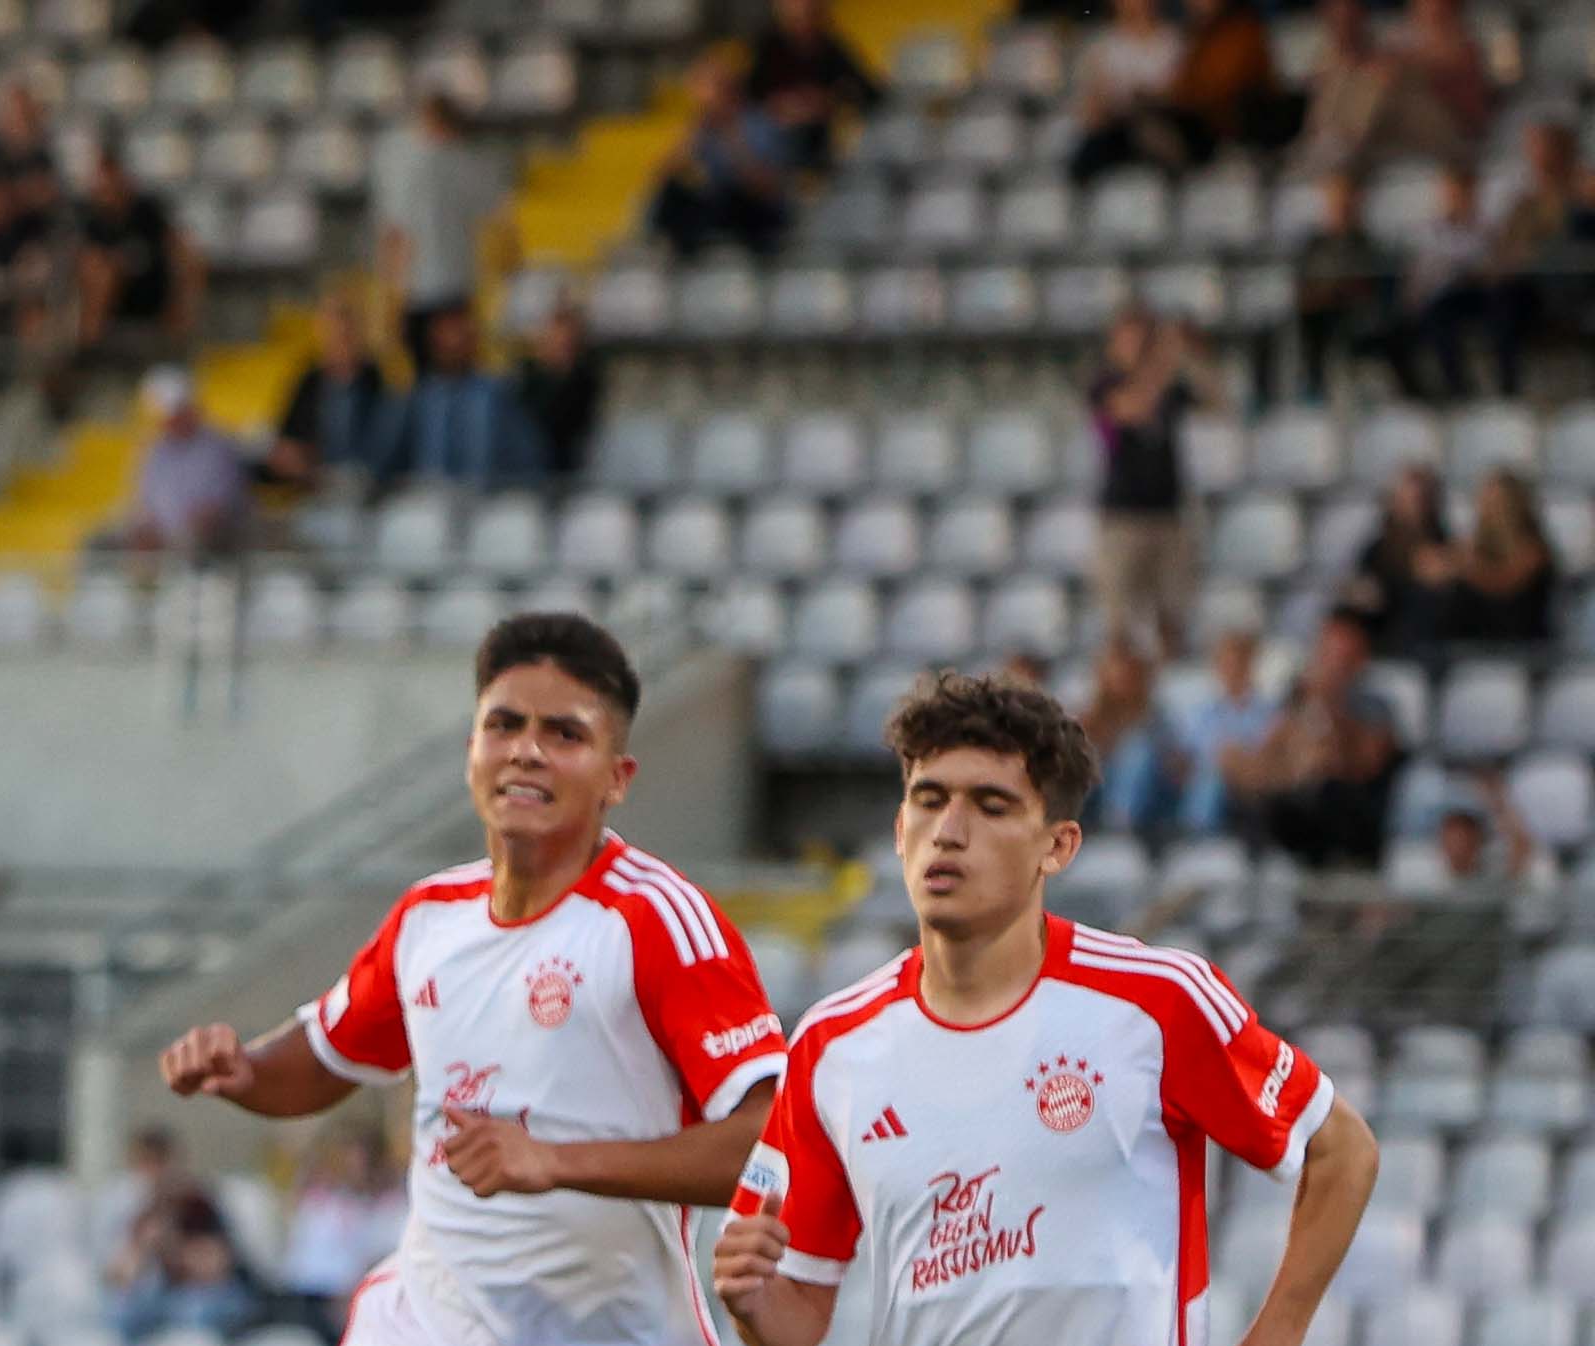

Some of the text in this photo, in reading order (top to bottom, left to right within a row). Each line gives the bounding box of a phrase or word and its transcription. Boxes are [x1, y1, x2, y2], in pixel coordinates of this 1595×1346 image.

[928, 1164, 1001, 1221] ROT
[930, 1190, 993, 1248] GEGEN
[912, 1204, 1044, 1293] RASSISMUS
